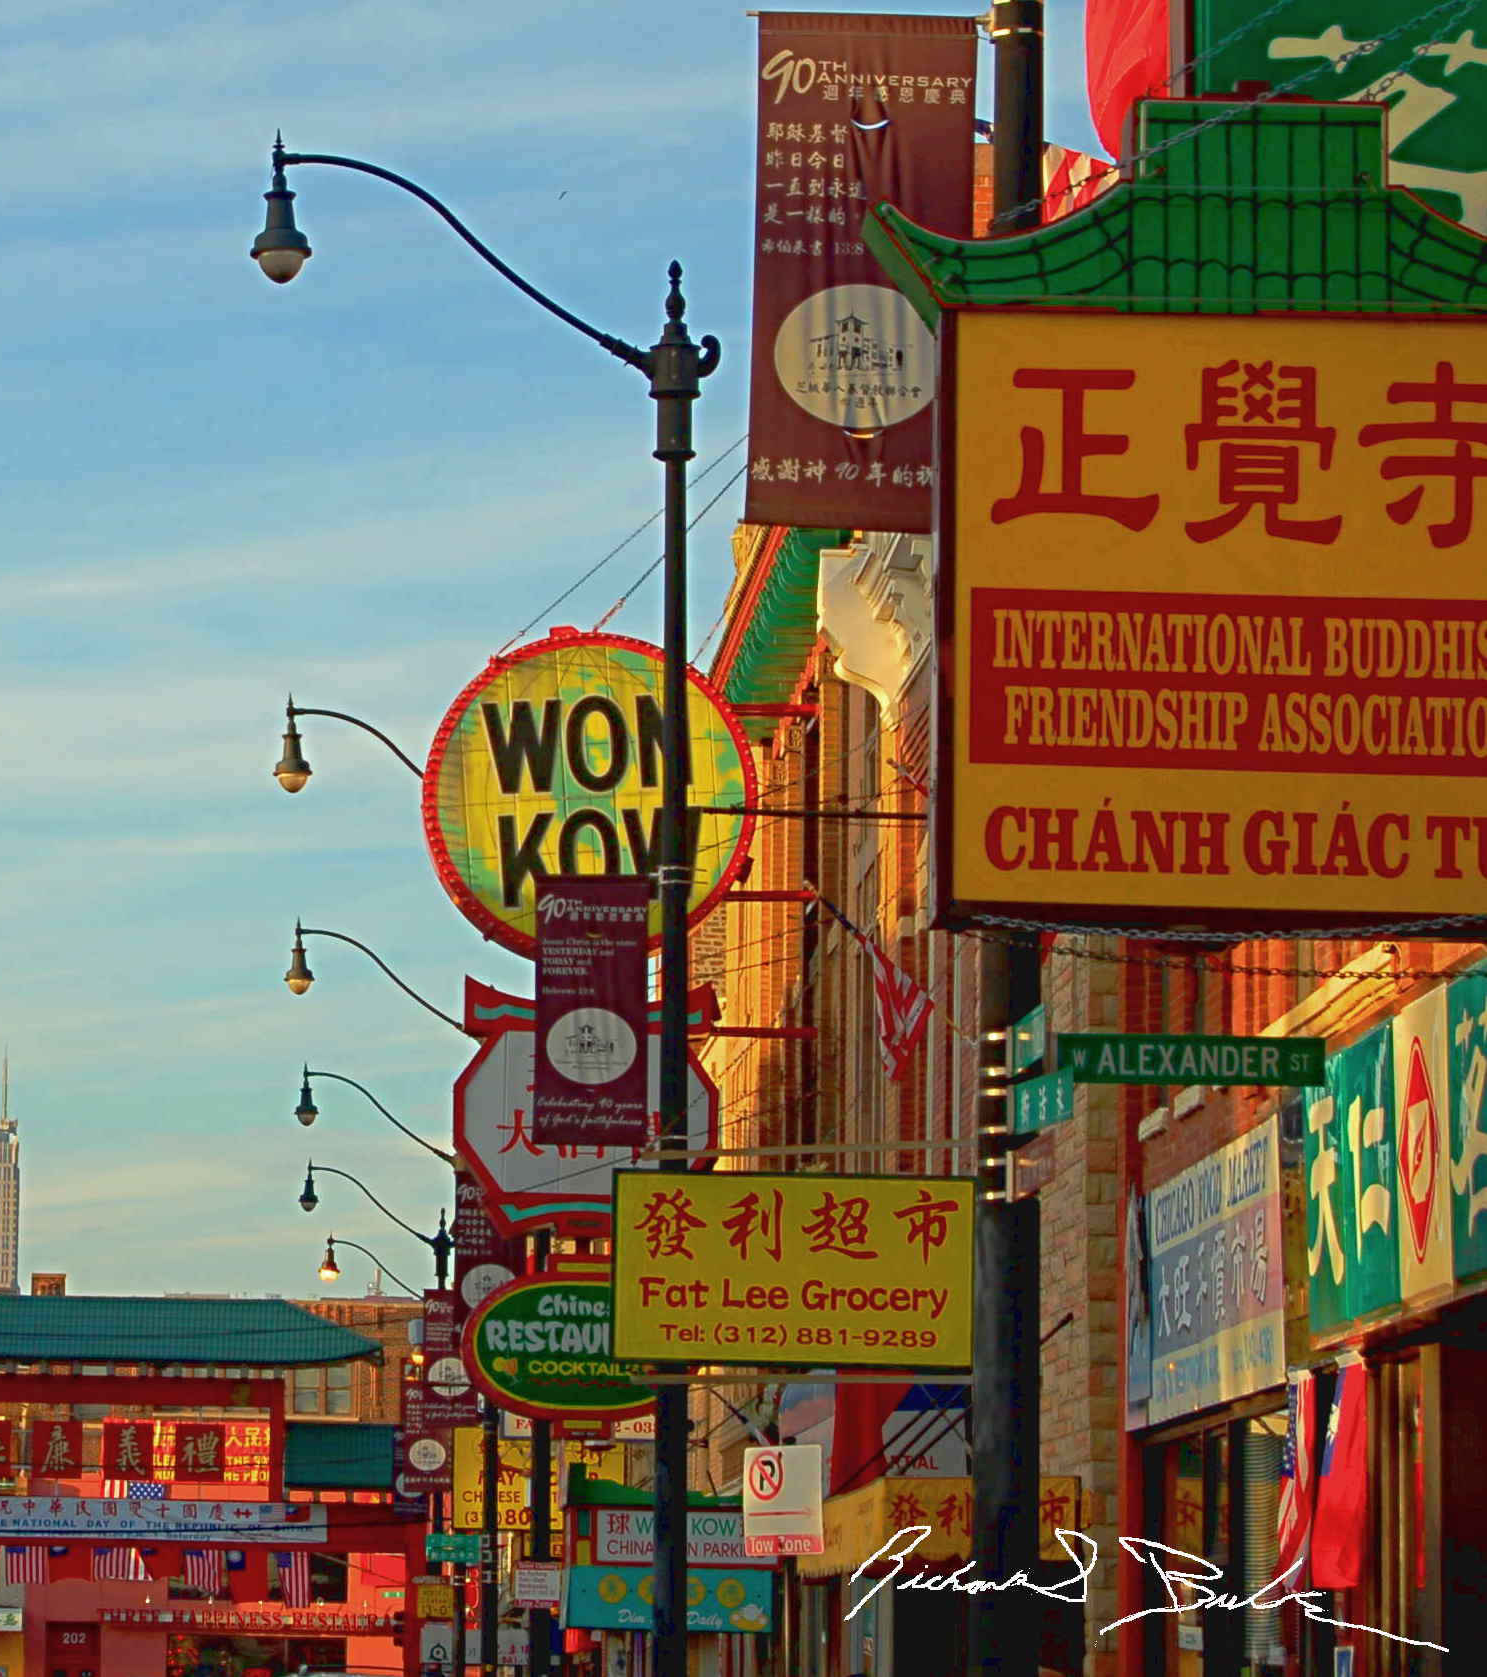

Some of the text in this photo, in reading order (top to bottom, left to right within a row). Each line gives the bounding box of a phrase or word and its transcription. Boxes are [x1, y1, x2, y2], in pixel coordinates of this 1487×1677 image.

[817, 72, 973, 89] ANNIVERSARY
[765, 151, 845, 169] 昨日今日
[990, 359, 1487, 548] 正覺寺
[992, 608, 1311, 678] INTERNATIONAL
[1004, 685, 1248, 753] FRIENDSHIP
[984, 797, 1230, 876] CHÁNH
[1244, 801, 1410, 879] GIÁC
[1073, 1043, 1311, 1078] W ALEXANDER ST
[1154, 1177, 1195, 1247] CHICAGO
[634, 1188, 960, 1265] 發利超市
[538, 1293, 610, 1318] Chine
[639, 1276, 948, 1319] Fat Lee Grocery
[660, 1323, 938, 1349] Tel: (312) 881-9289
[13, 1517, 77, 1529] NATIONAL
[86, 1518, 112, 1529] DAY
[120, 1519, 135, 1529] OF
[145, 1519, 173, 1530] THE
[174, 1520, 237, 1532] REPUBLIC
[691, 1517, 736, 1537] KOW
[702, 1541, 746, 1559] PARKI
[749, 1536, 811, 1554] Tow Zone
[96, 1607, 398, 1632] THREE HAPPINESS RESTAURA
[617, 1608, 645, 1624] Dim
[62, 1631, 87, 1646] 202
